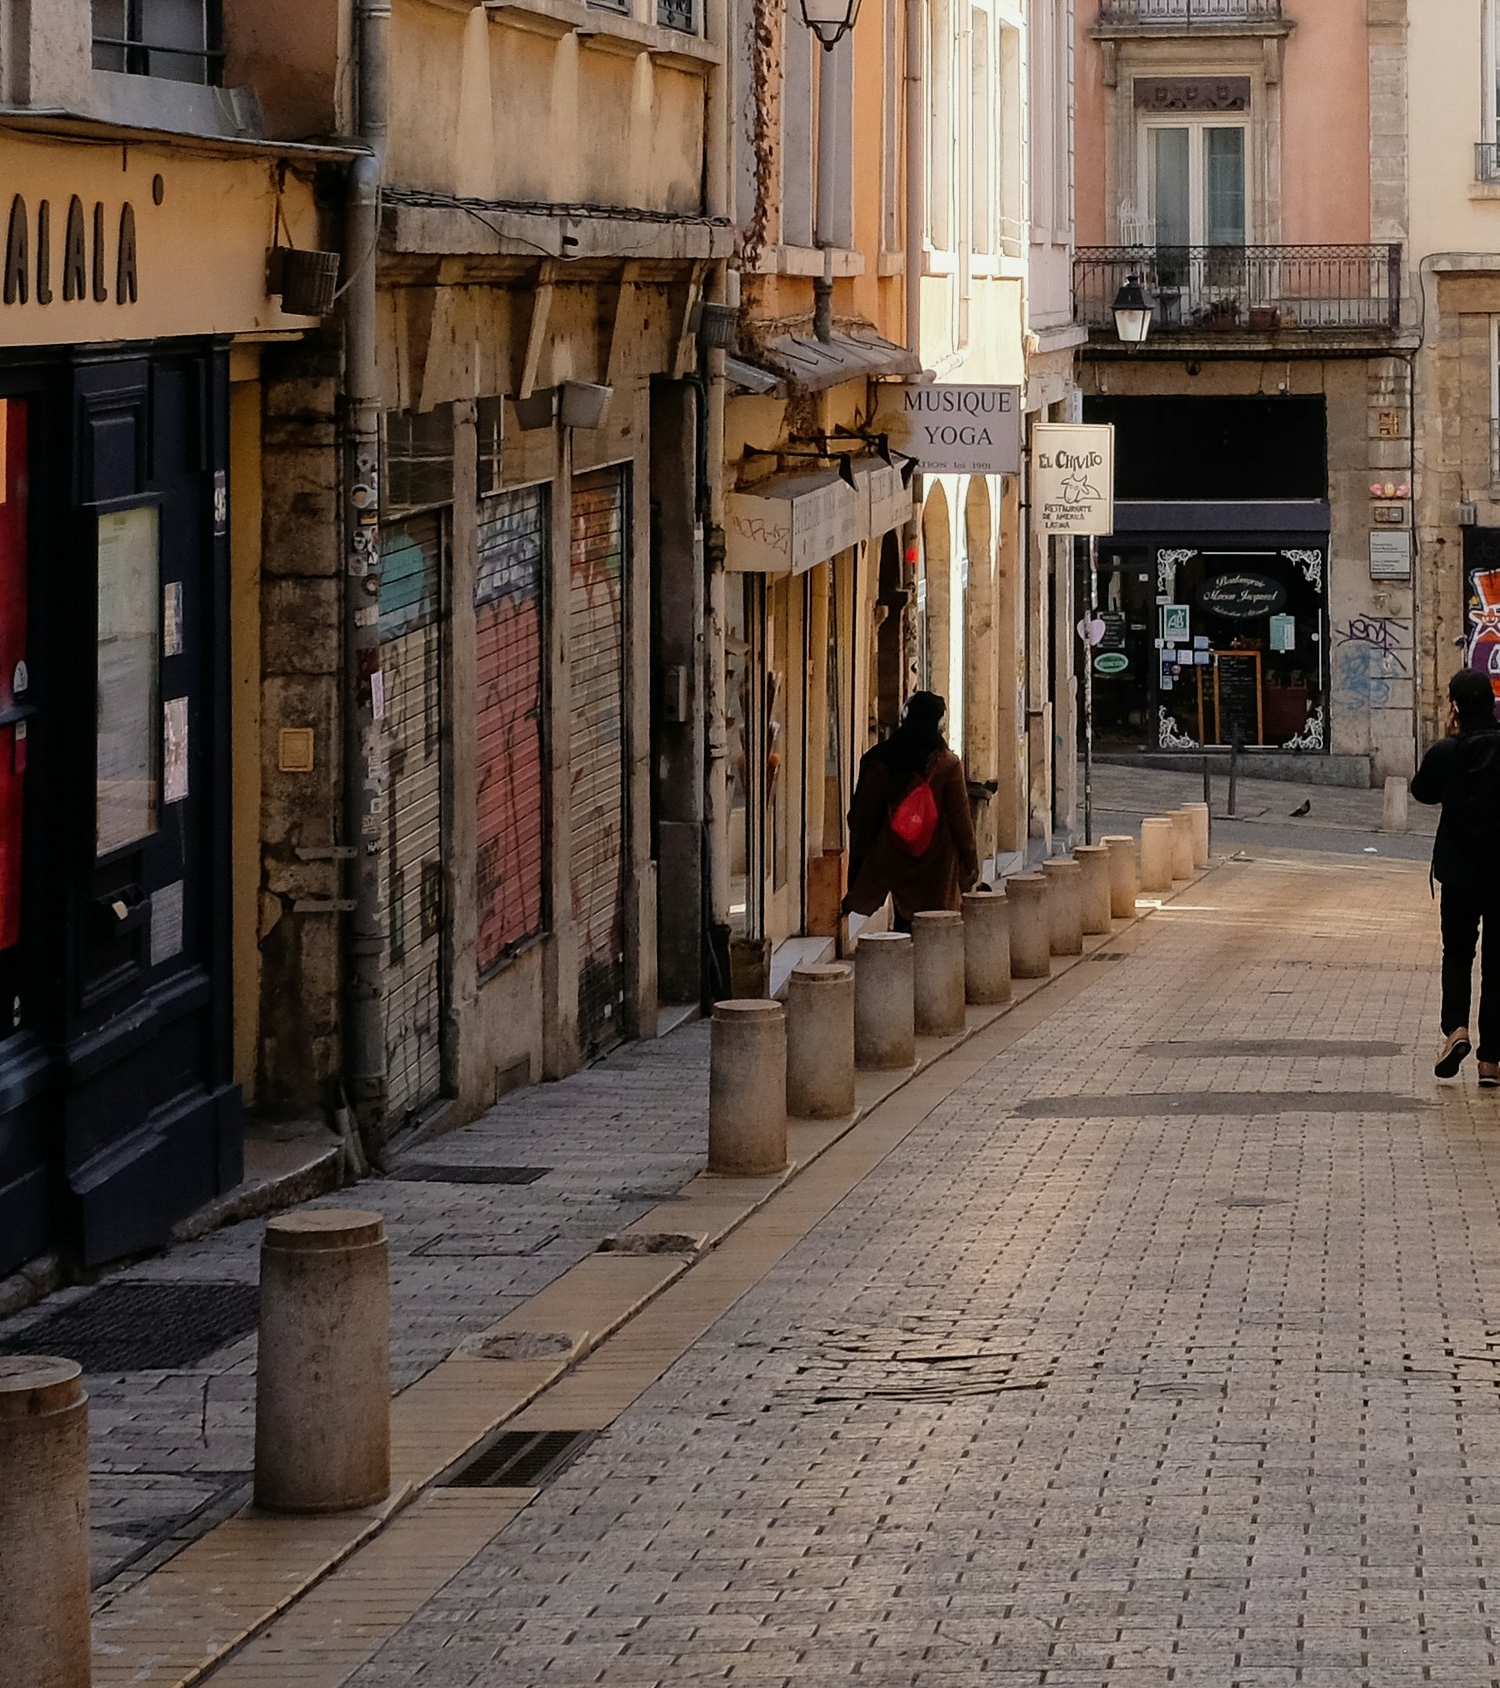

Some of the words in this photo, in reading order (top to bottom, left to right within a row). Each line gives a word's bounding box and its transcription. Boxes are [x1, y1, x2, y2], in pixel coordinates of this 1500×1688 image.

[903, 390, 1012, 417] MUSIQUE
[924, 425, 994, 446] YOGA
[1038, 453, 1053, 469] EL
[1055, 450, 1103, 472] CHIVITO
